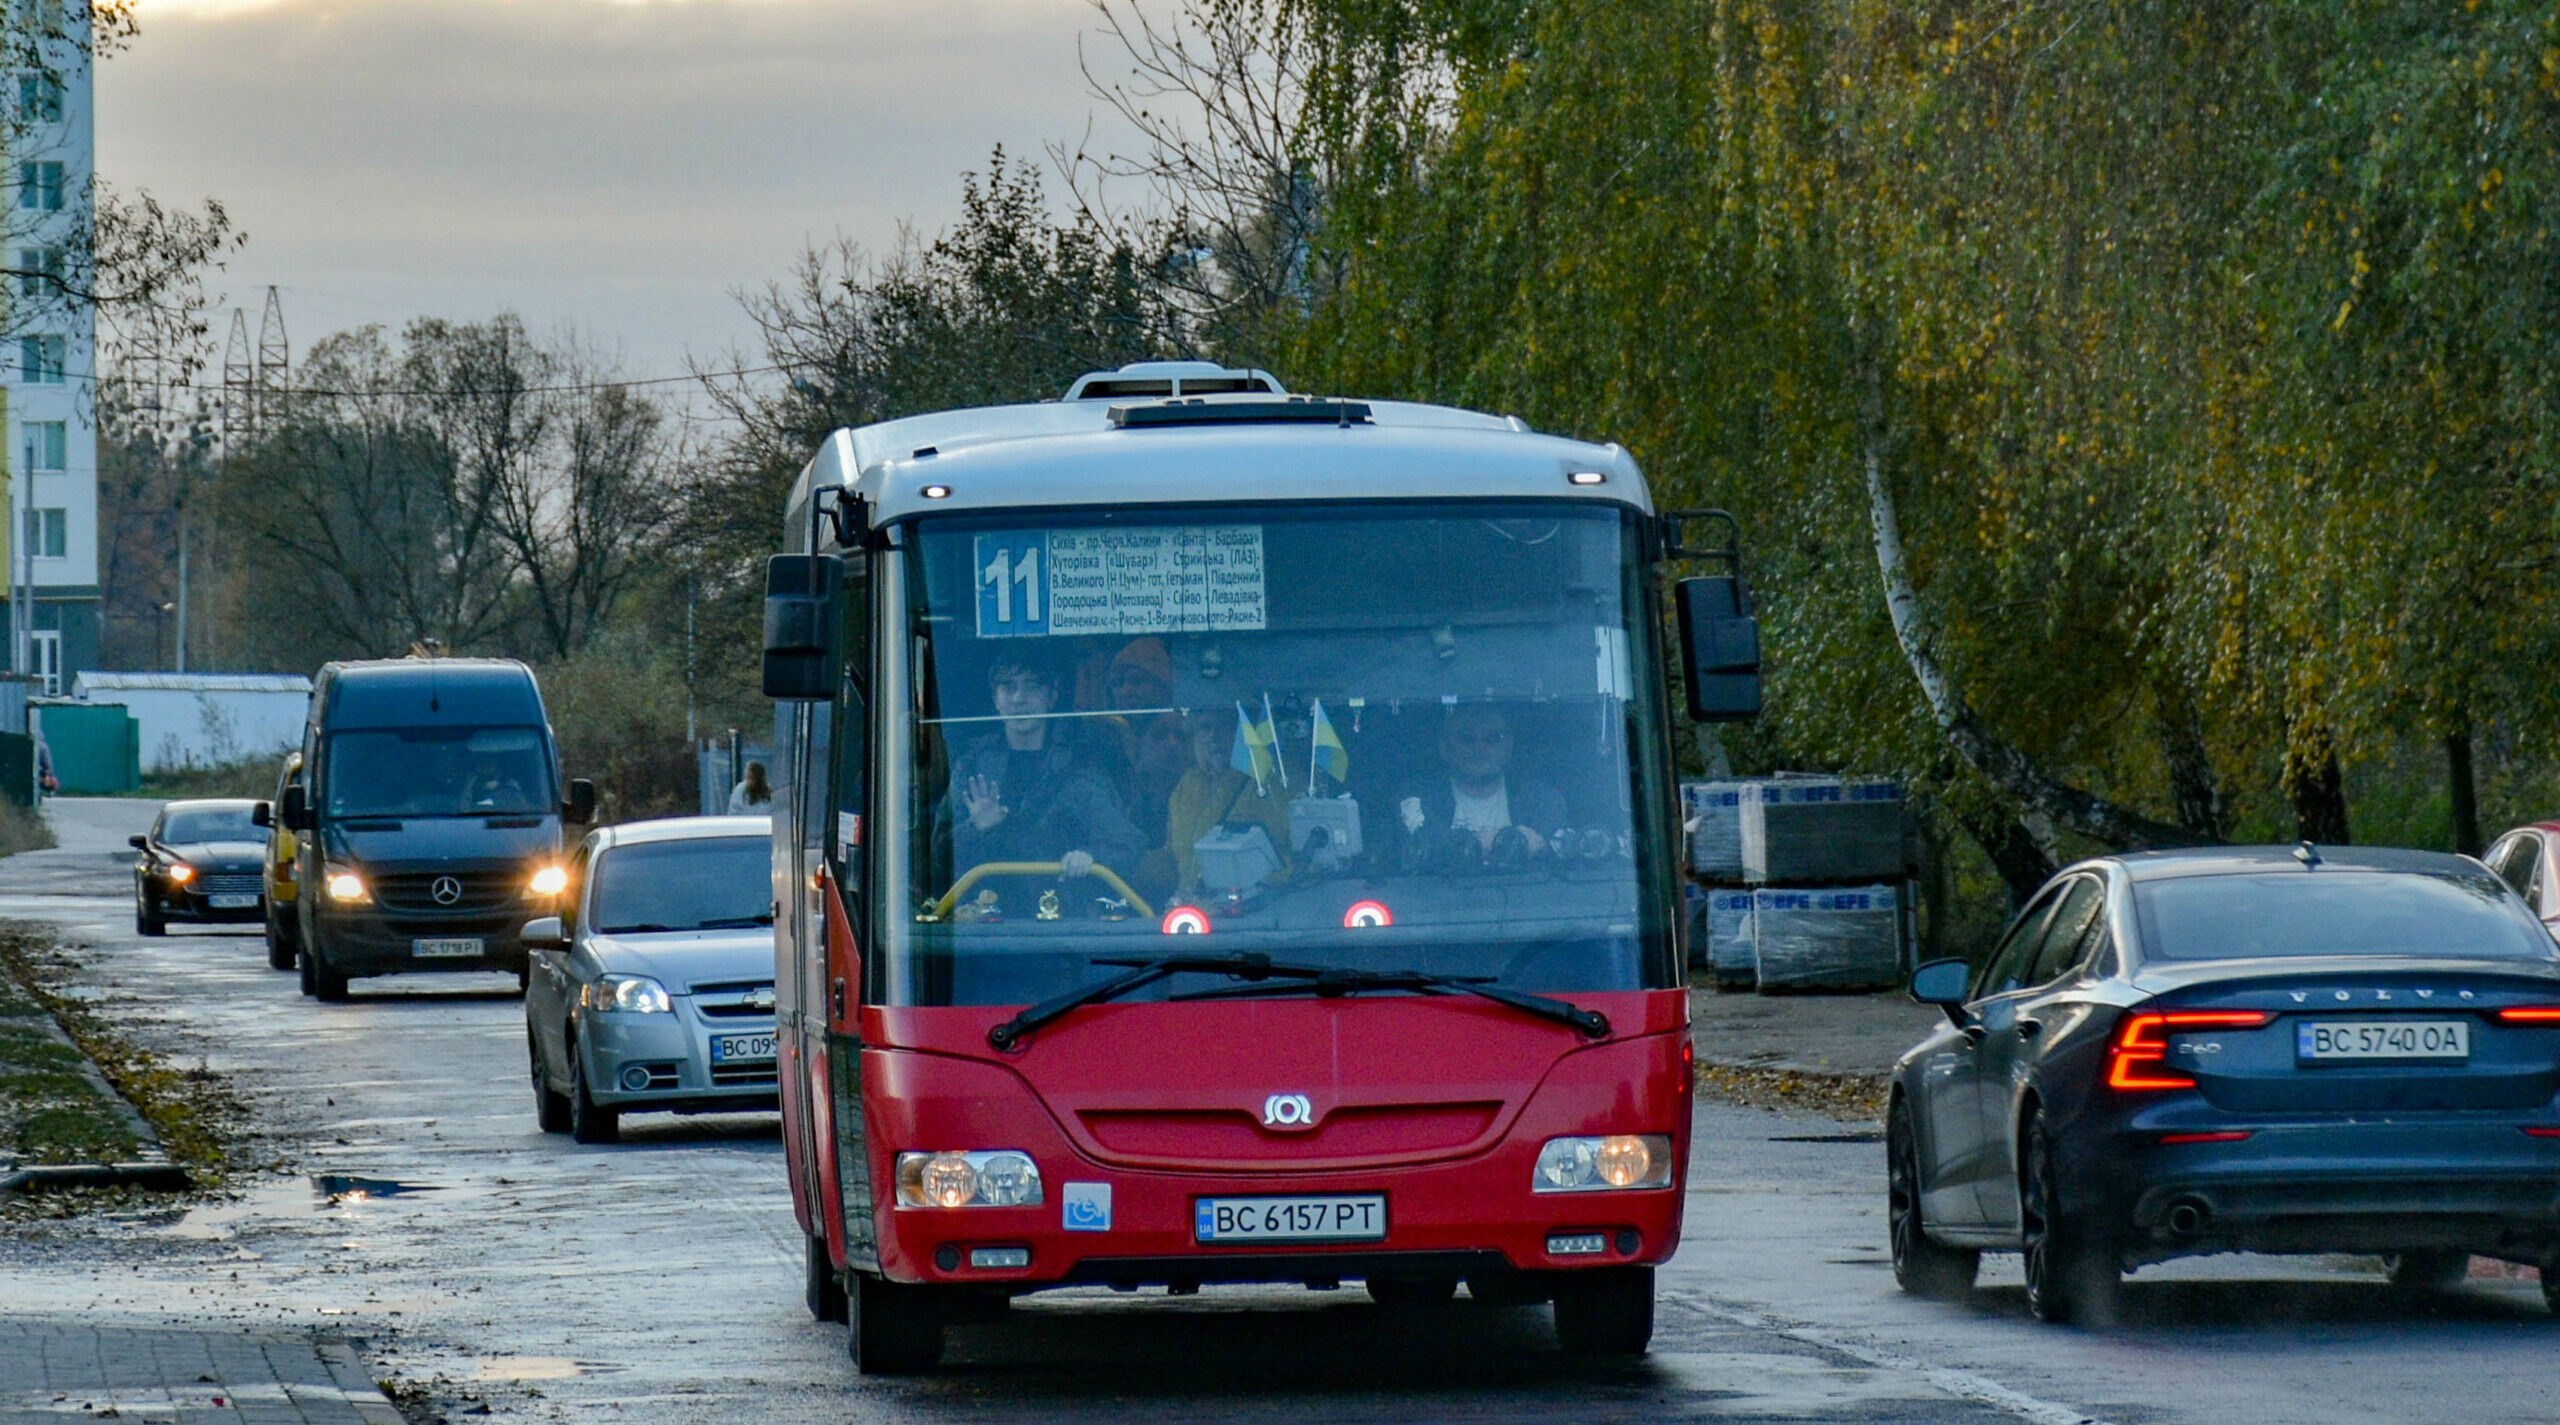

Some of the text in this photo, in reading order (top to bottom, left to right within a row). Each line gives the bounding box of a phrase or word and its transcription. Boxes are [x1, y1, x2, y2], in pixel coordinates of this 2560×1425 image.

[1052, 553, 1100, 572] Хуторівка
[985, 547, 1040, 622] 11
[1211, 568, 1261, 587] Південний
[1053, 593, 1107, 611] Городоцька
[2289, 989, 2475, 1003] VOLVO
[722, 1039, 747, 1057] BC
[2314, 1026, 2460, 1053] BC 5740 OA
[1216, 1202, 1377, 1233] BC 6157 PT
